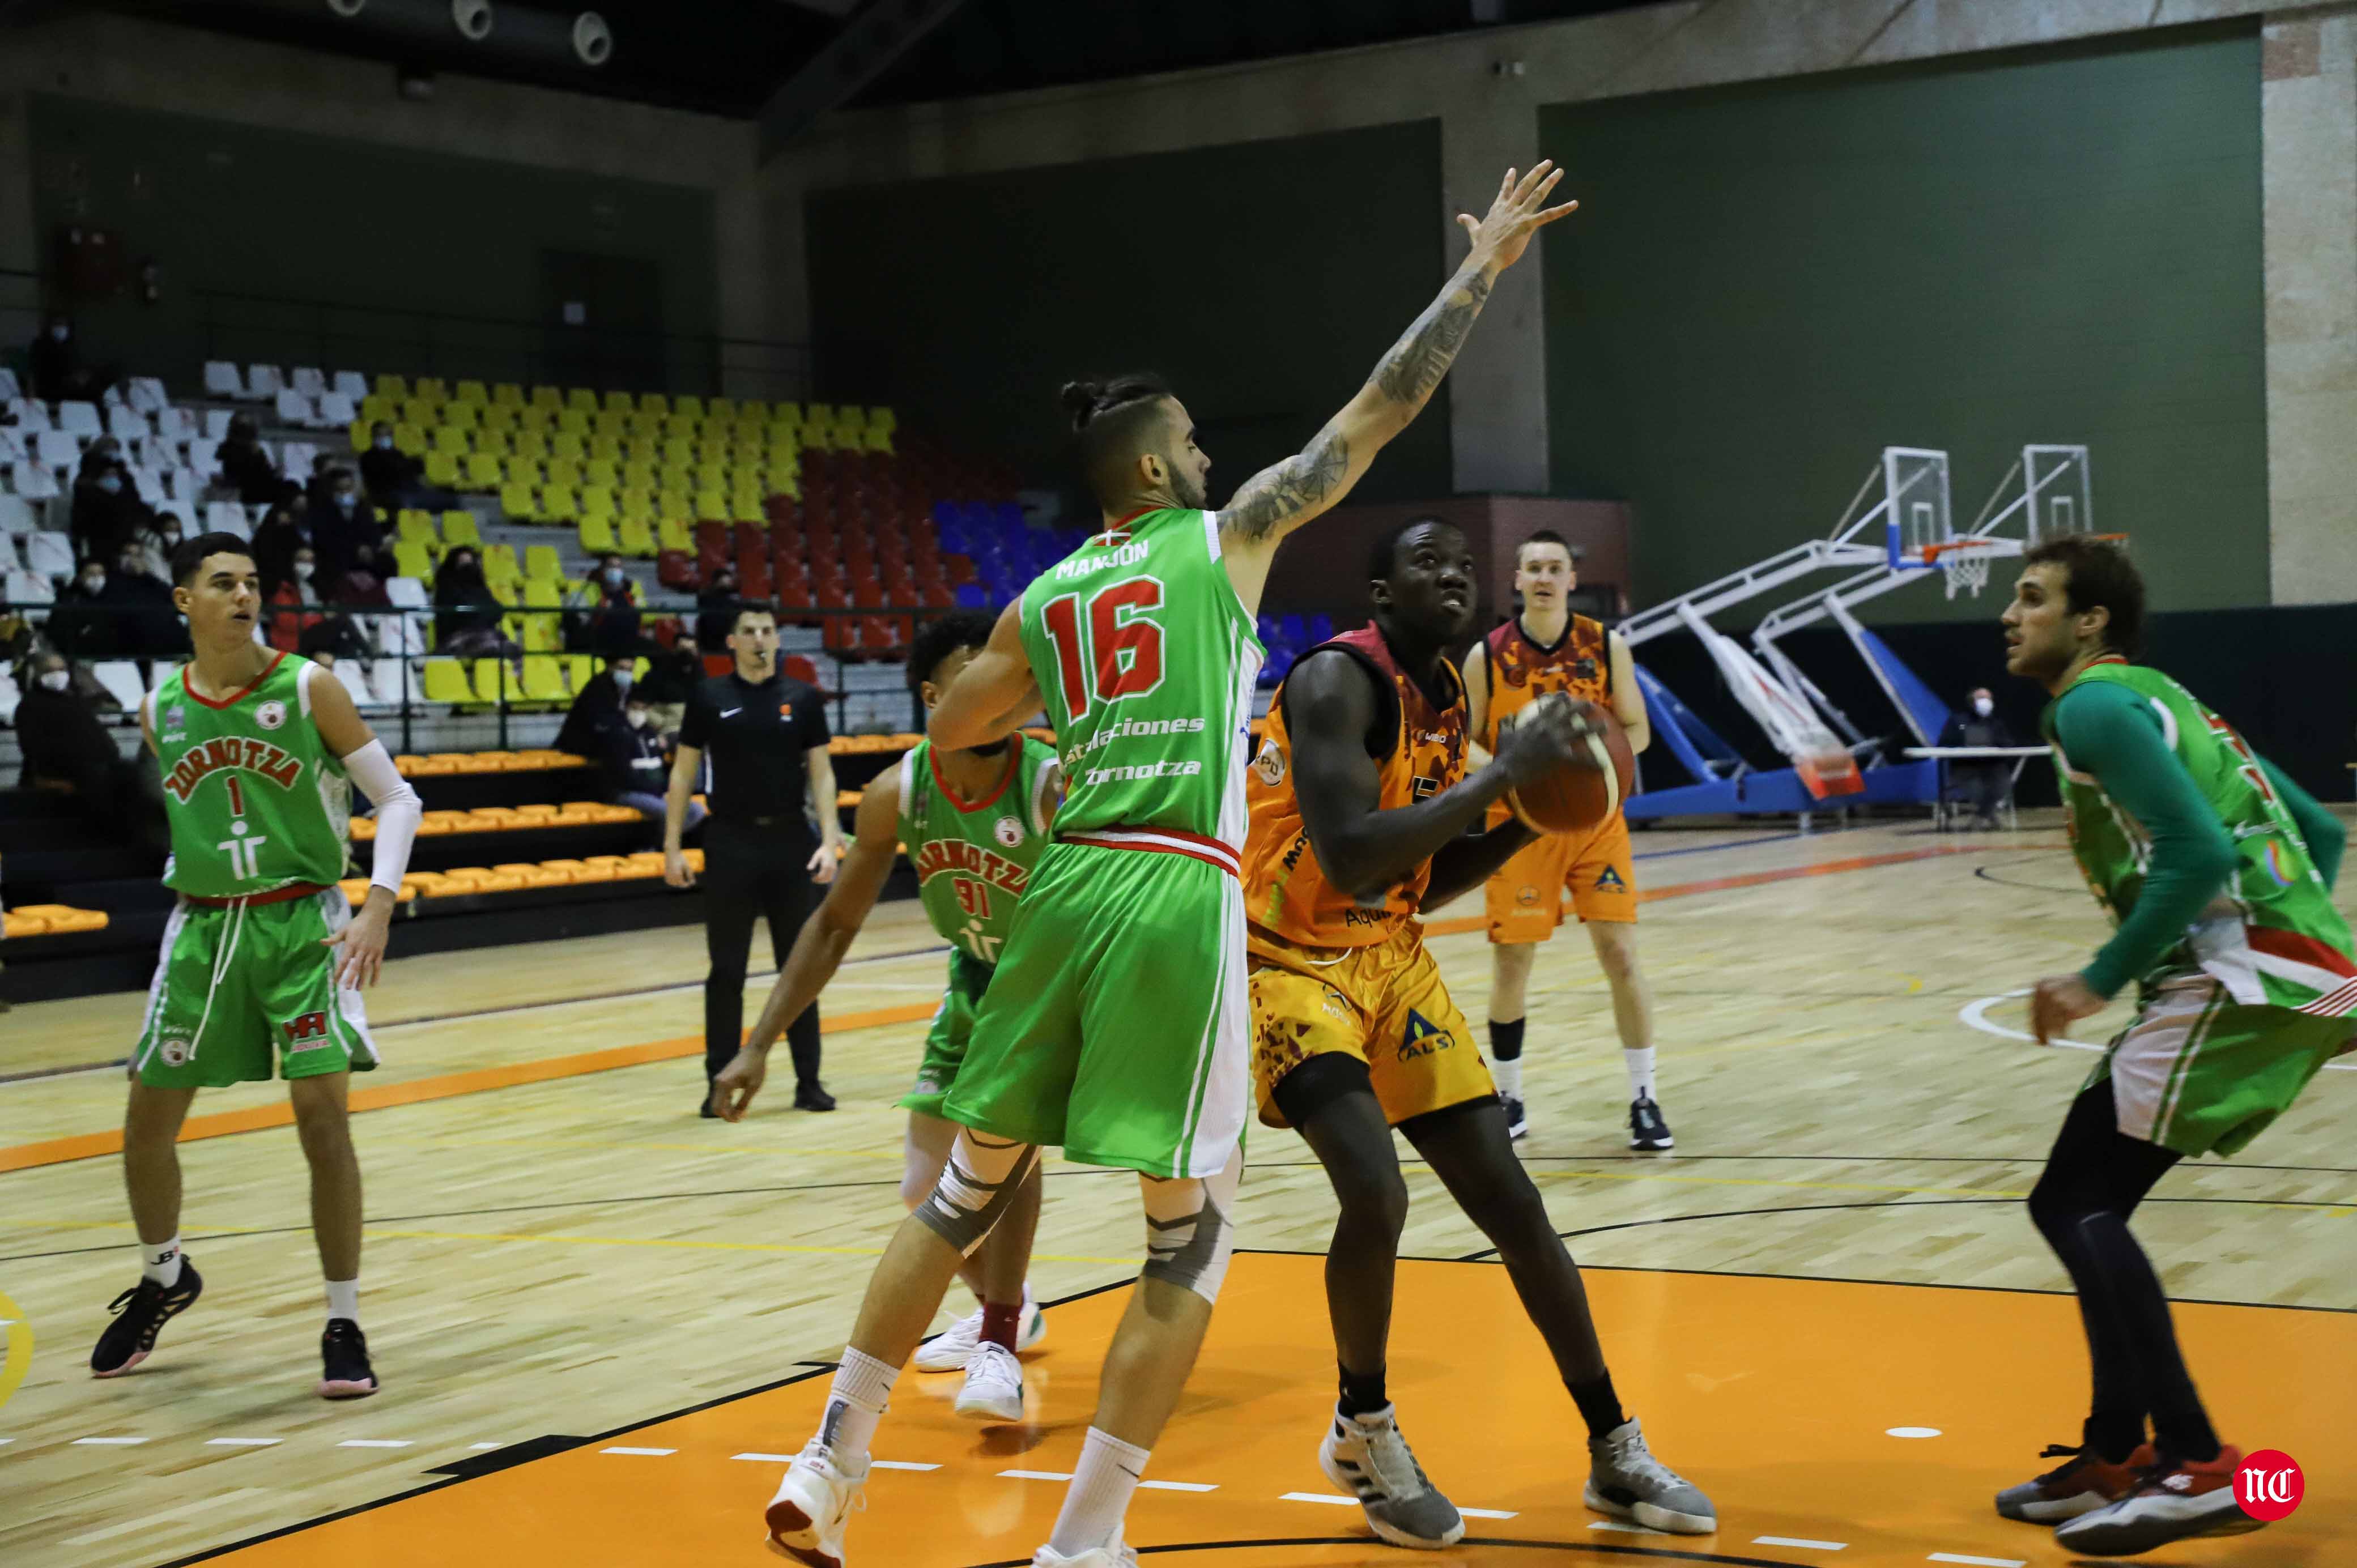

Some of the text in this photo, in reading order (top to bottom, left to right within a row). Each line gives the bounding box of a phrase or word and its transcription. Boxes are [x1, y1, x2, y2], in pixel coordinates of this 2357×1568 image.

[1041, 574, 1165, 726] 16
[163, 736, 304, 805] ZORNOTZA
[224, 774, 245, 816] 1
[1406, 1036, 1449, 1061] ALS
